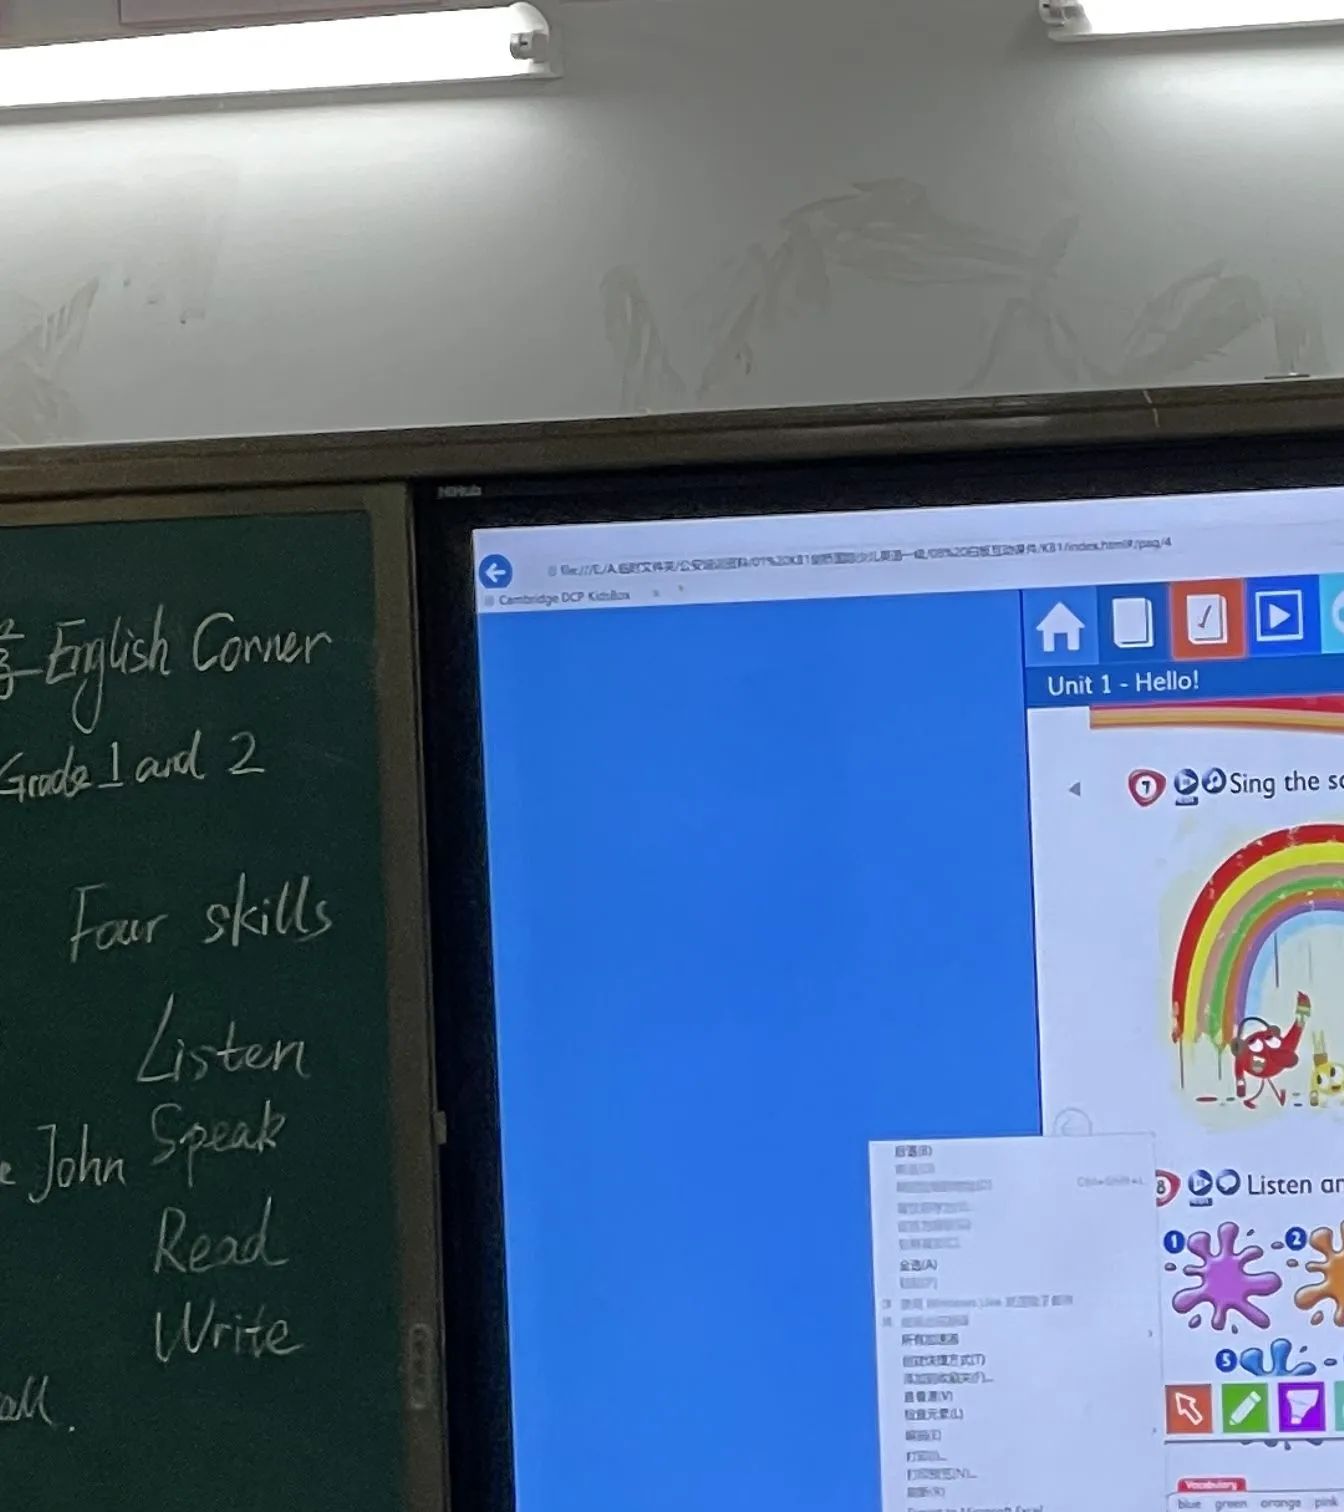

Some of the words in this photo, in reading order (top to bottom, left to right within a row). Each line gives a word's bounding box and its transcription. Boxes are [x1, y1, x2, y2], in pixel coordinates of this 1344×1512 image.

[46, 603, 171, 735] English
[192, 612, 332, 673] Corner
[1049, 674, 1092, 699] Unit
[1101, 673, 1112, 696] 1
[1136, 669, 1200, 694] Hello!
[0, 745, 92, 803] Grade
[135, 730, 205, 782] and
[228, 731, 265, 775] 2
[1230, 772, 1276, 801] Sing
[1284, 769, 1321, 793] the
[70, 885, 168, 963] Four
[204, 872, 333, 946] skills
[137, 992, 310, 1083] Listen
[28, 1123, 126, 1203] John
[151, 1100, 286, 1188] Speak
[1247, 1173, 1312, 1197] Listen
[154, 1196, 289, 1273] Read
[155, 1301, 304, 1363] Write
[1215, 1499, 1248, 1512] green
[1260, 1498, 1301, 1511] orange
[1314, 1496, 1338, 1511] pink
